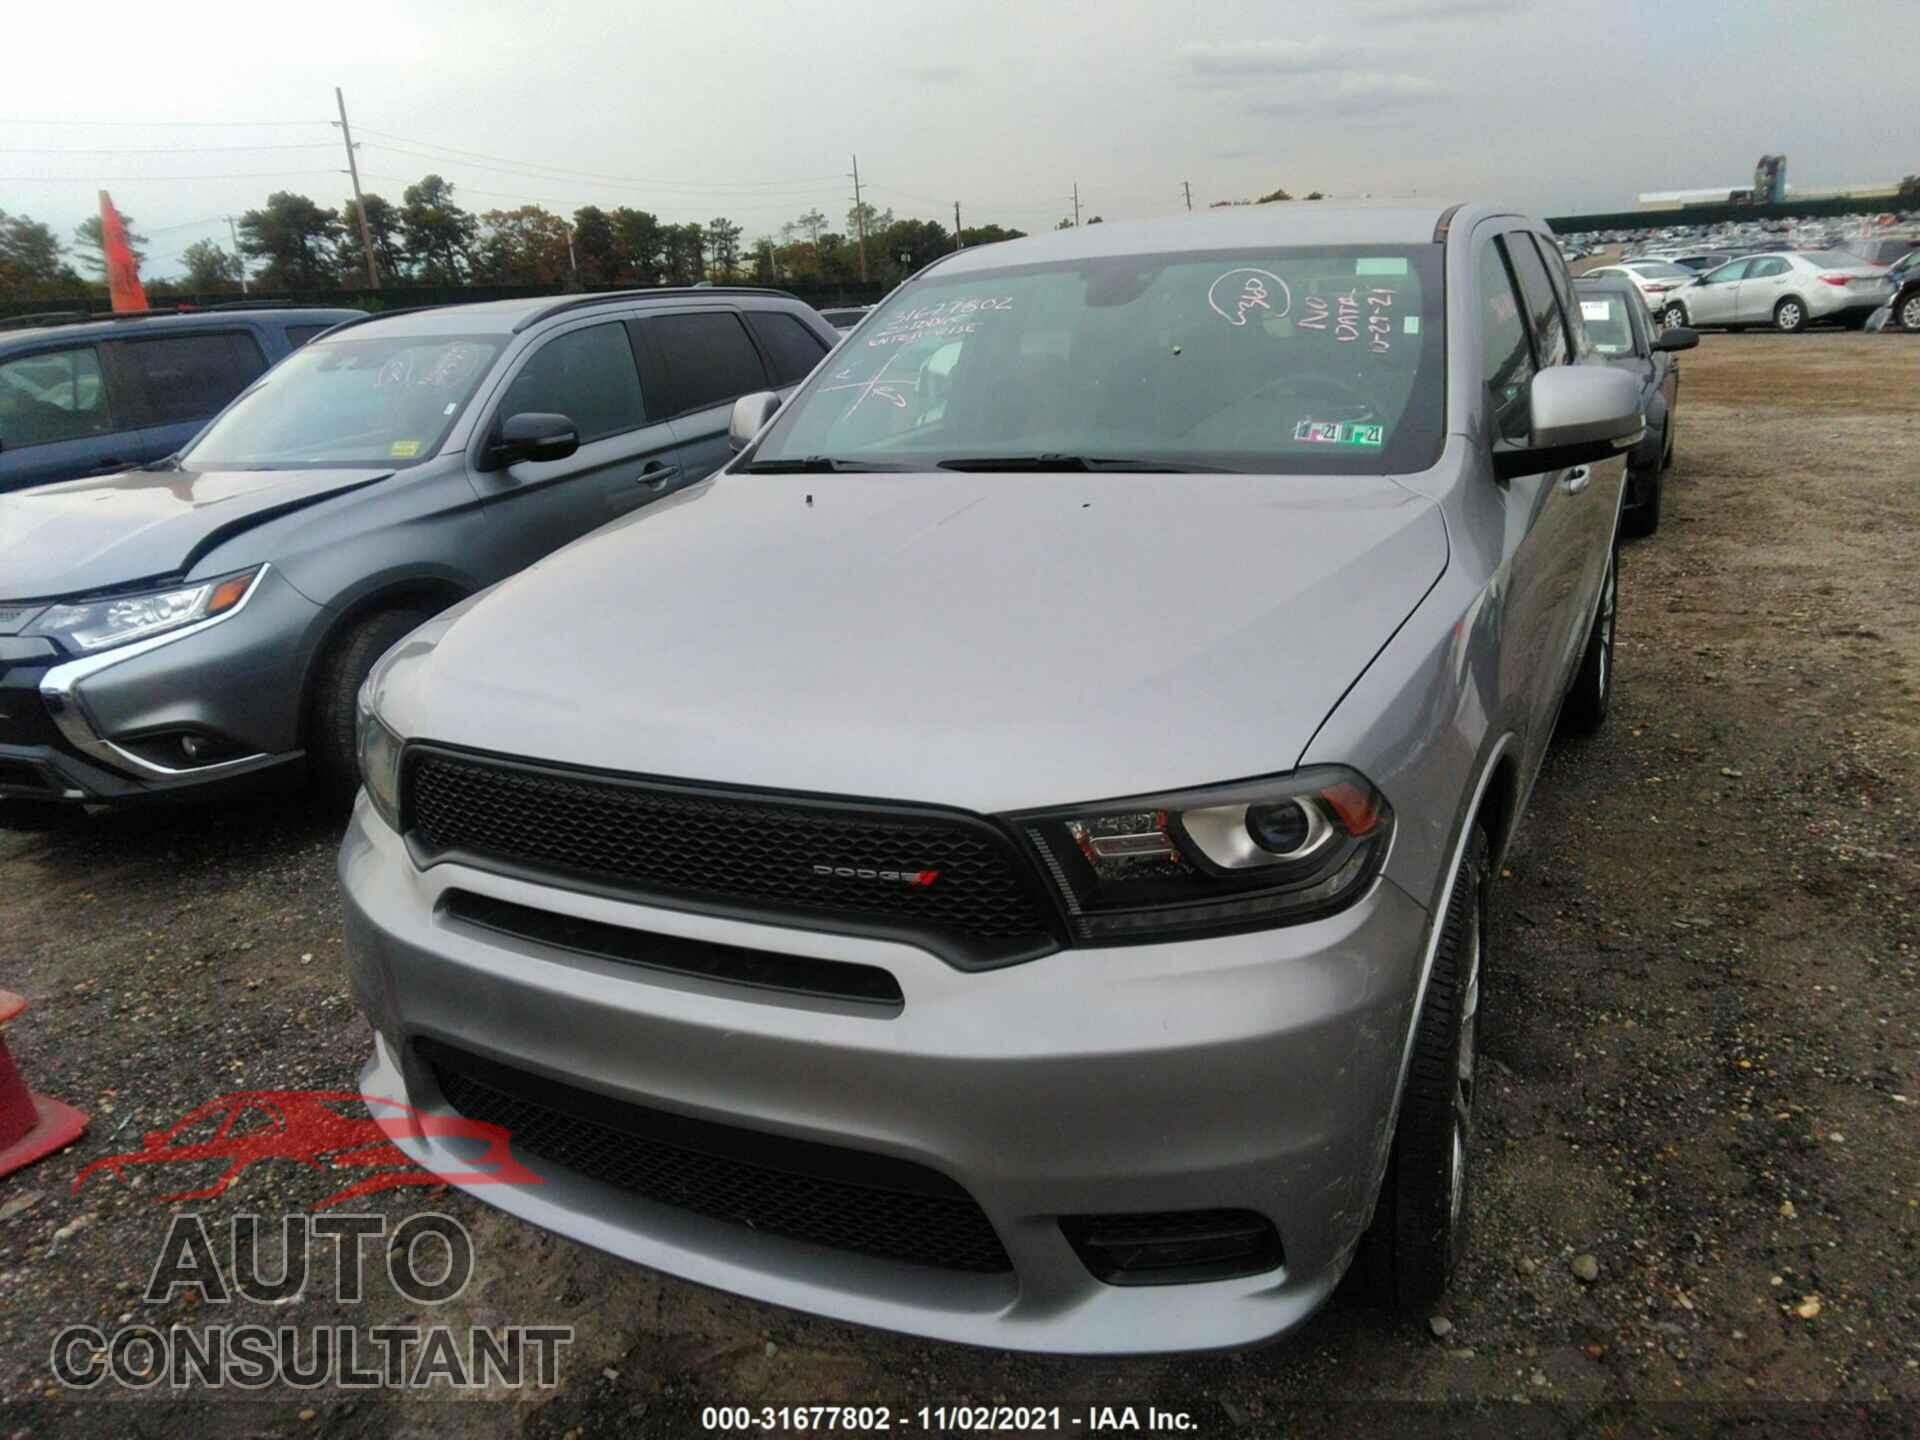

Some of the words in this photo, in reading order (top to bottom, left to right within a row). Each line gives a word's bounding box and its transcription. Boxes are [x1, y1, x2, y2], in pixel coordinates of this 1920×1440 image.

[1323, 424, 1337, 439] 21
[1367, 426, 1380, 442] 21
[812, 864, 919, 882] DODGE
